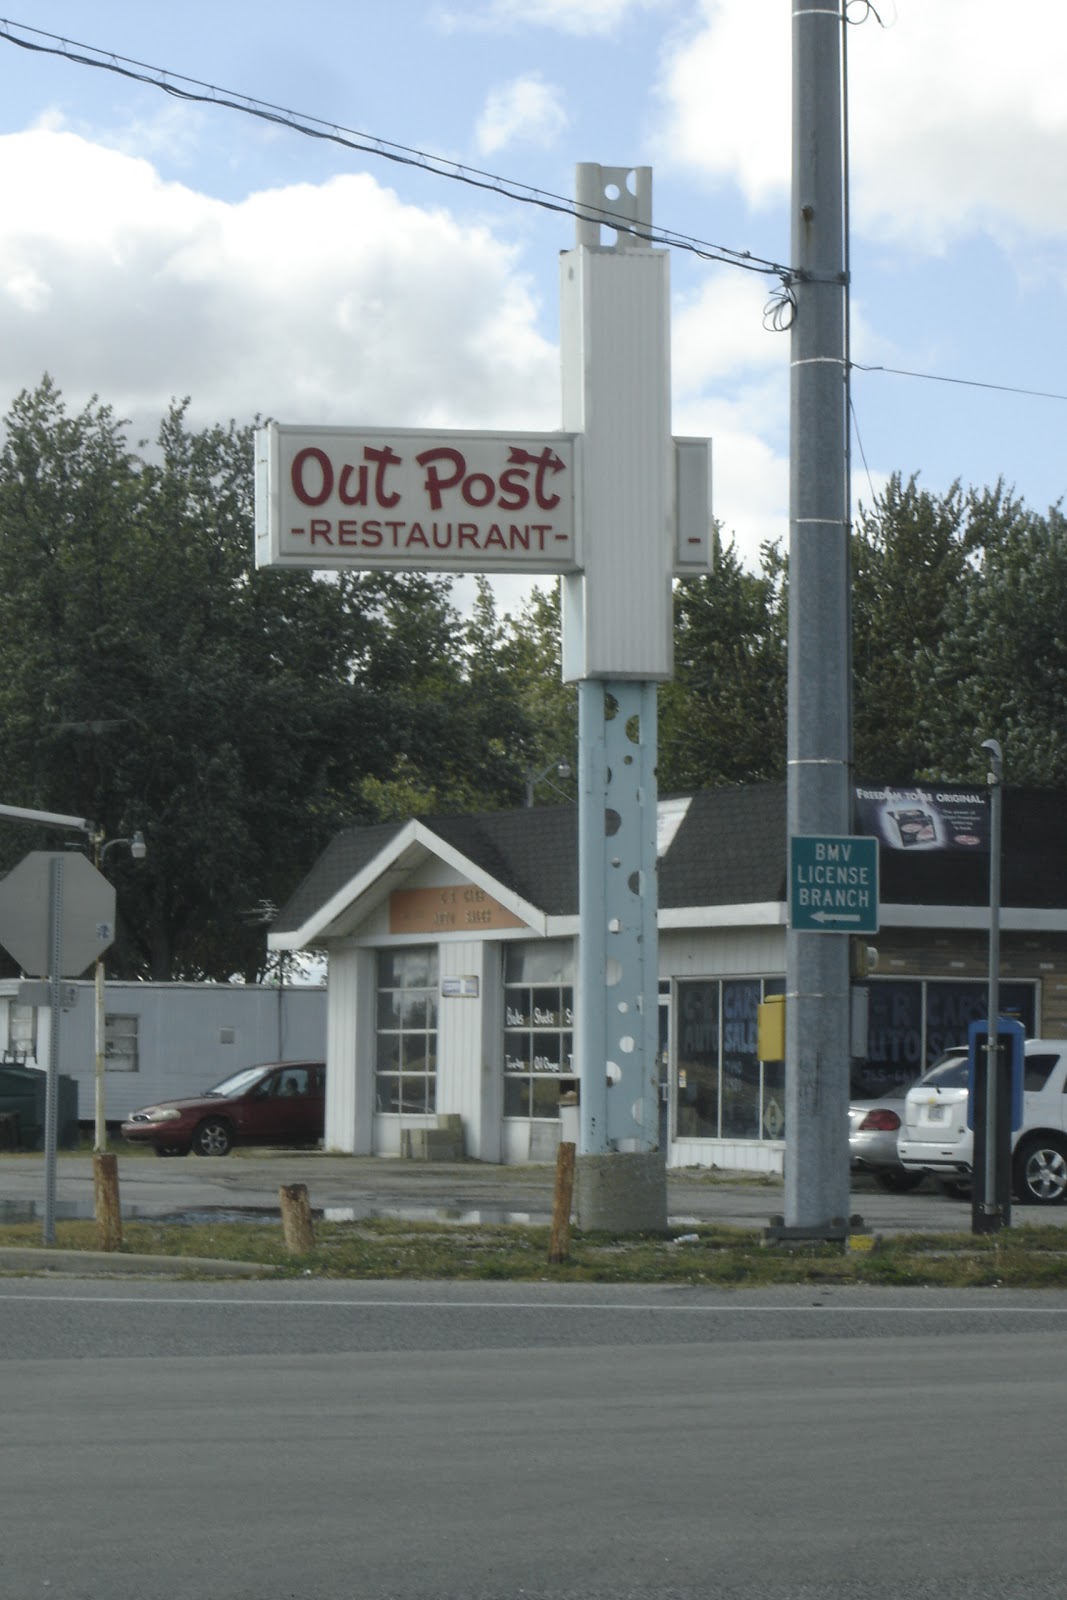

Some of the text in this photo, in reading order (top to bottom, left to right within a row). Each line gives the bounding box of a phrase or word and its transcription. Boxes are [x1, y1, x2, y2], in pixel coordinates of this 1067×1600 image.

[291, 446, 566, 510] Out Post
[815, 843, 852, 861] BMV
[797, 864, 869, 884] LICENSE
[799, 888, 869, 907] BRANCH
[868, 1029, 920, 1062] UTO
